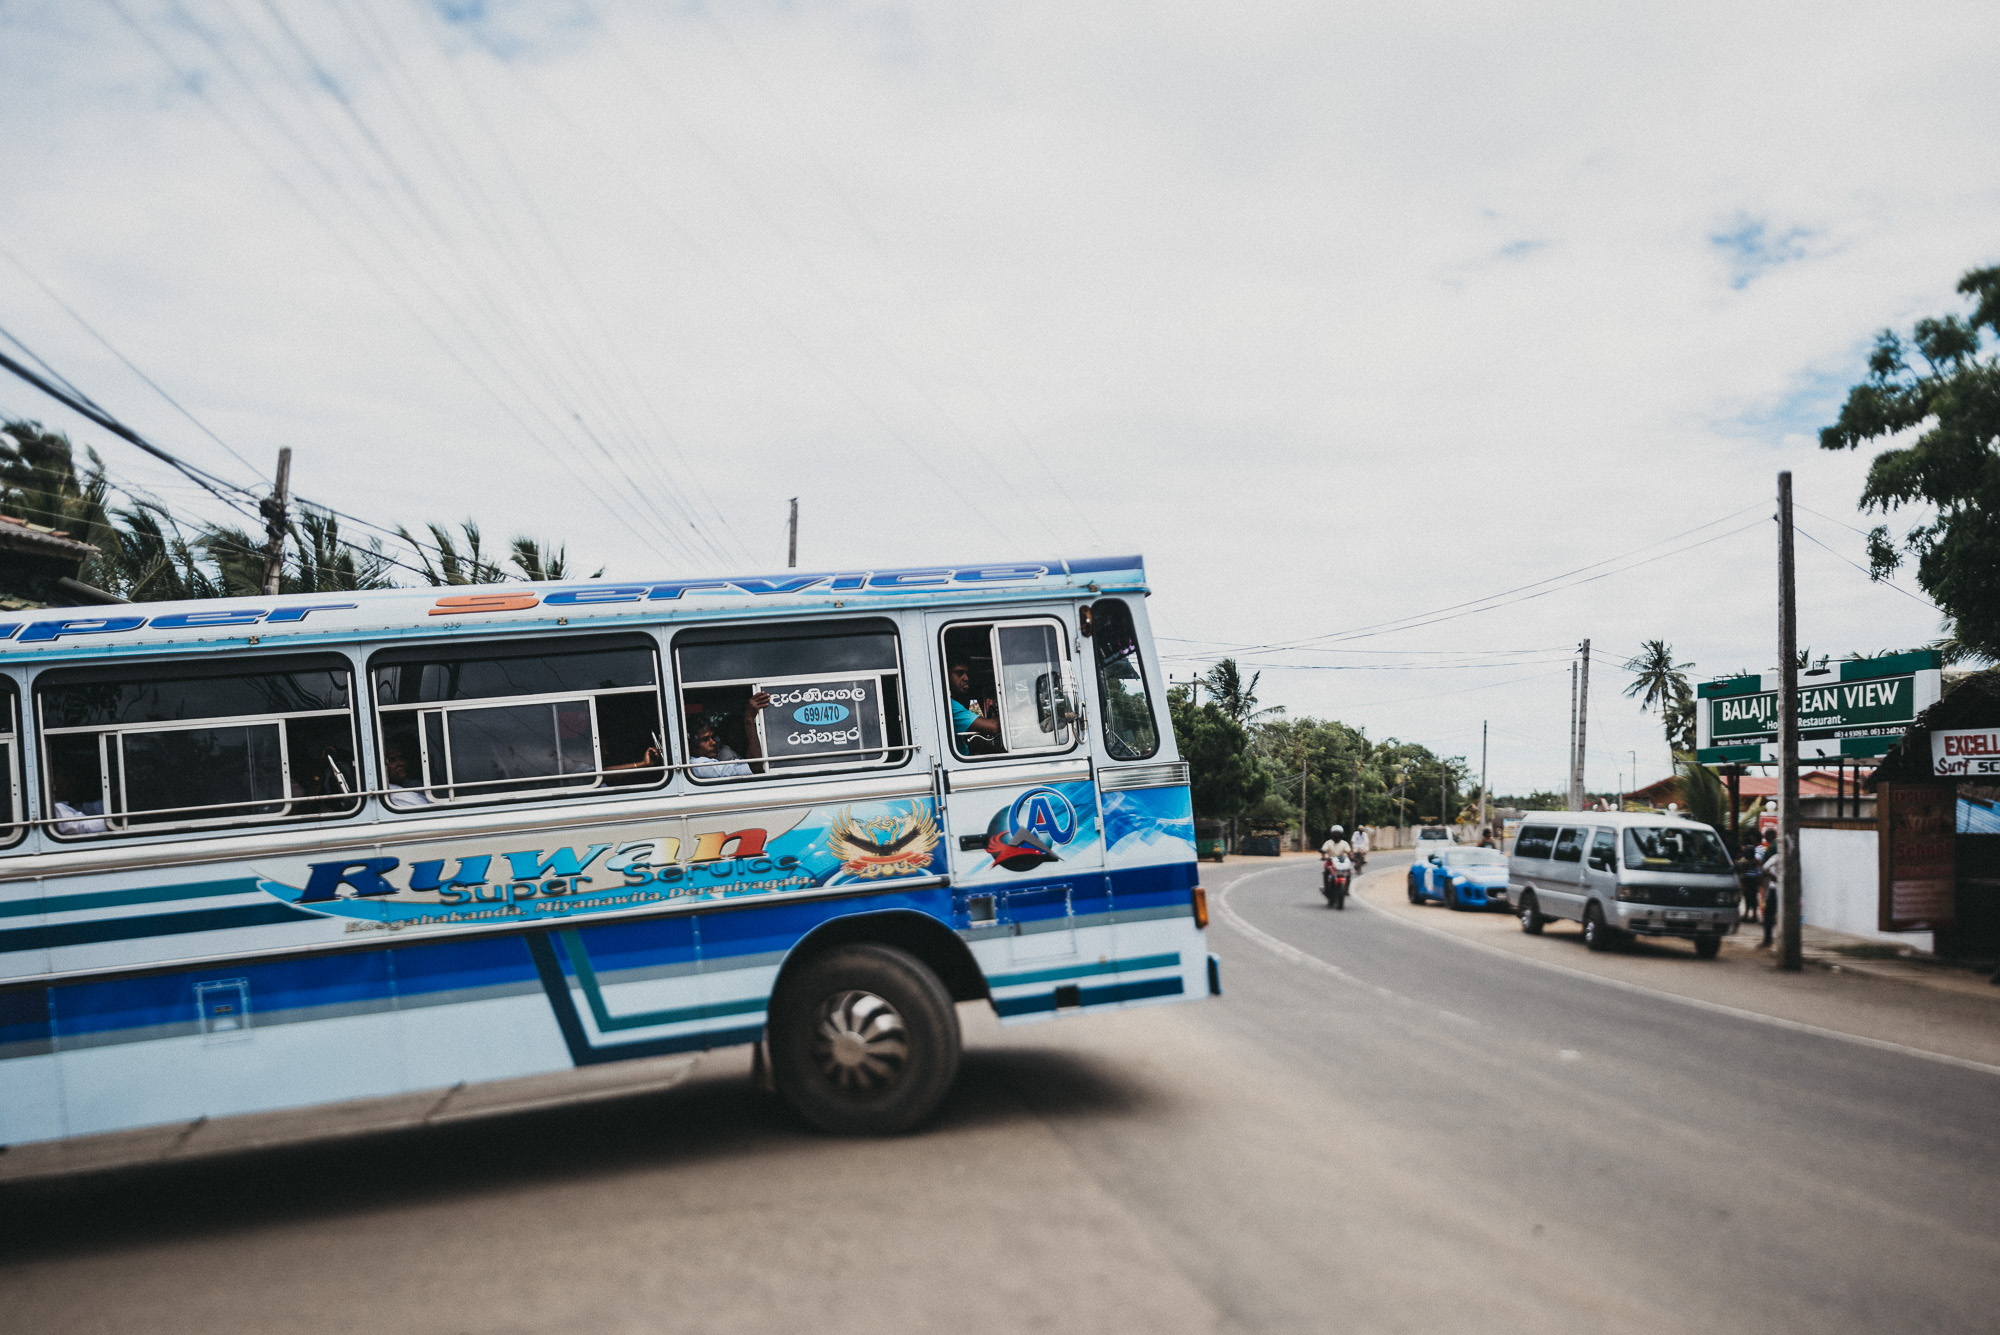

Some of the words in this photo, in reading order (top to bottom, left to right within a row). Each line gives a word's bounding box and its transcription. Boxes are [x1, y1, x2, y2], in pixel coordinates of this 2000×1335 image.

[1722, 696, 1771, 723] BALAJI
[1776, 688, 1838, 714] EAN
[1843, 681, 1900, 709] VIEW
[803, 706, 840, 722] 699/470
[1797, 715, 1841, 728] Restaurant
[787, 726, 860, 745] රත්නපුර
[1935, 757, 1970, 775] Surf
[294, 827, 768, 903] Ruwan
[438, 876, 593, 907] Super
[623, 854, 800, 886] Service
